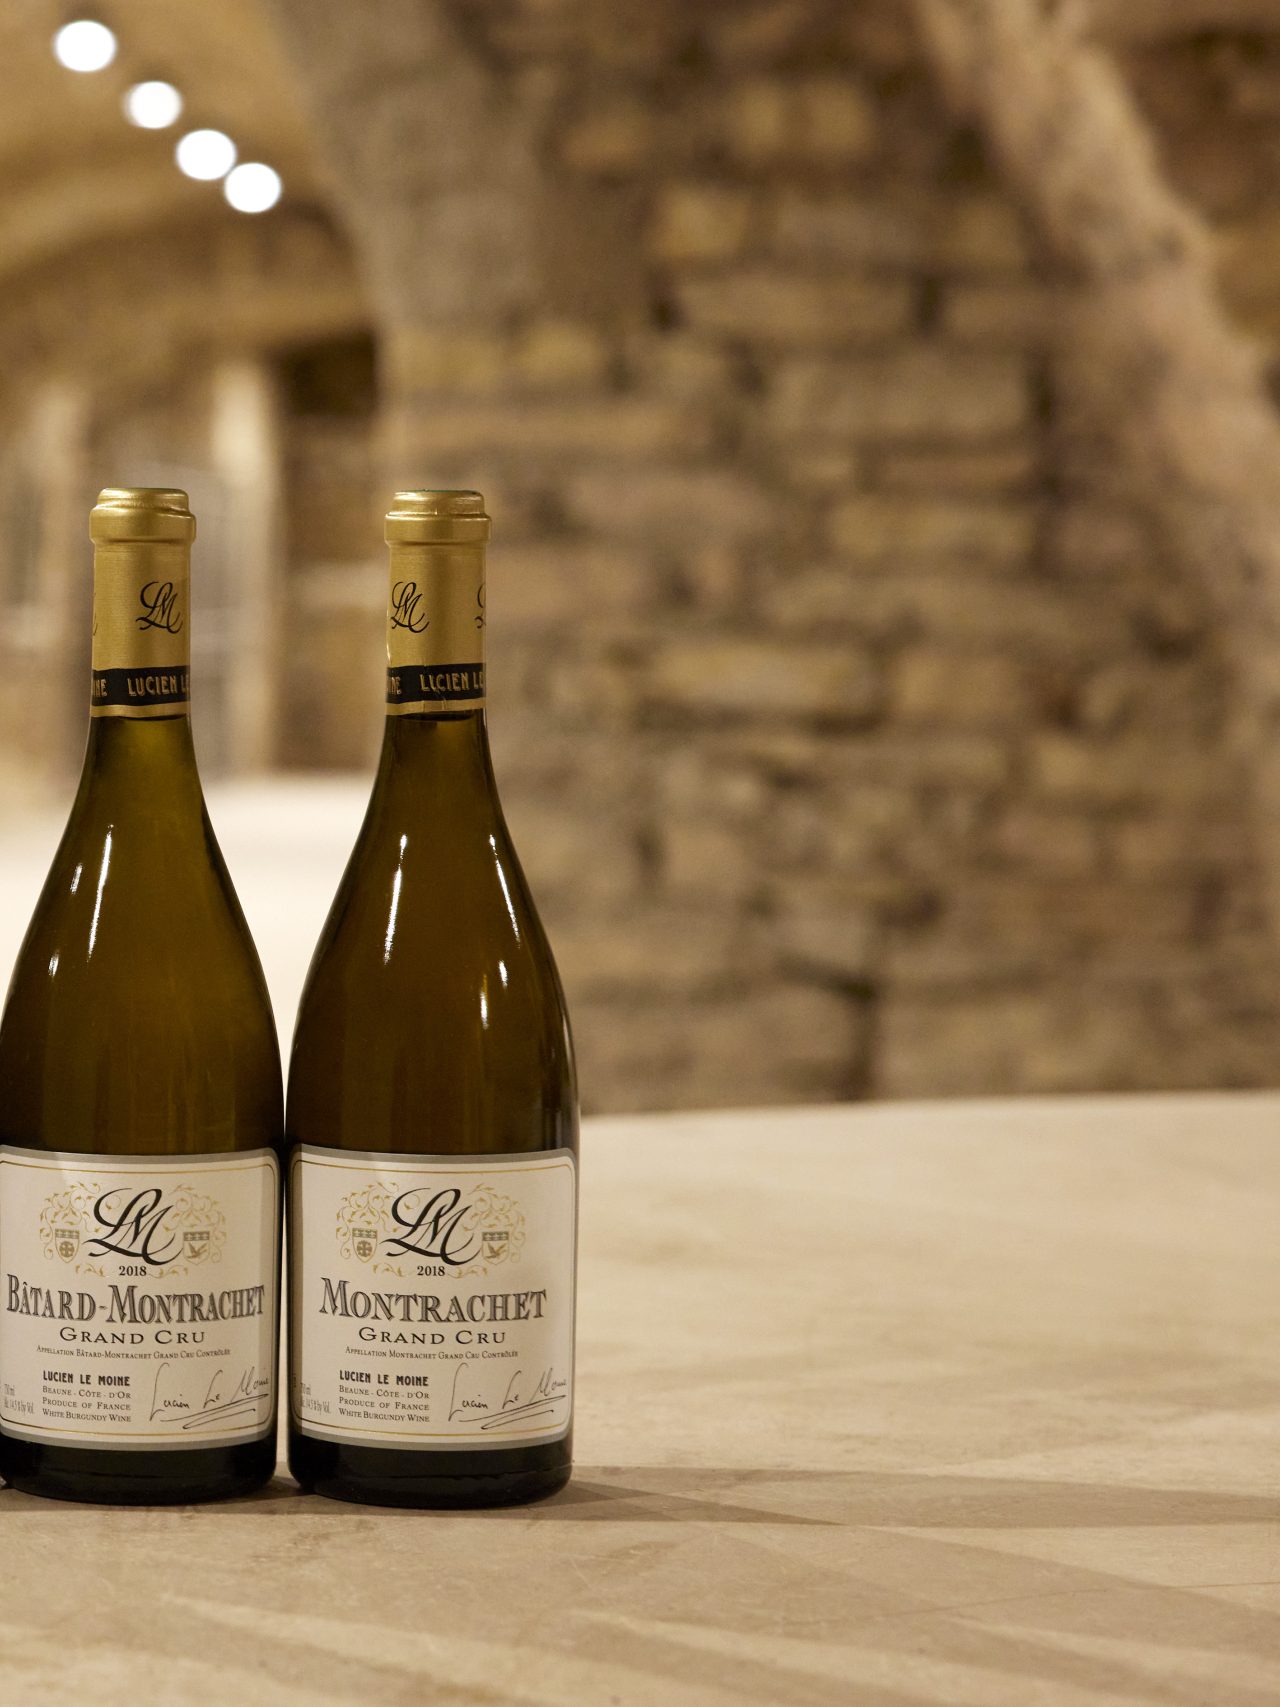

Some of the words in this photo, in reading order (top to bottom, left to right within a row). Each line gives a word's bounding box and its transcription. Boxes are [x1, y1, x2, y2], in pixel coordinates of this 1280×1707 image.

[127, 676, 178, 696] LUCIEN
[119, 1266, 147, 1276] 2018
[417, 1266, 445, 1276] 2018
[7, 1274, 265, 1324] BÂTARD-MONTRACHET
[319, 1277, 546, 1323] MONTRACHET
[60, 1327, 144, 1344] GRAND
[155, 1331, 205, 1344] CRU
[359, 1327, 445, 1344] GRAND
[456, 1331, 506, 1344] CRU
[37, 1345, 73, 1356] APPELLATION
[154, 1351, 178, 1359] GRAND
[345, 1346, 386, 1357] APPELLATION
[389, 1350, 436, 1359] MONTRACHET
[43, 1370, 73, 1383] LUCIEN
[80, 1374, 91, 1384] LE
[98, 1376, 130, 1386] MOINE
[340, 1370, 371, 1383] LUCIEN
[378, 1374, 389, 1384] LE
[396, 1375, 428, 1386] MOINE
[43, 1386, 71, 1395] BEAUNE
[79, 1389, 101, 1397] CÔTE
[339, 1385, 369, 1395] BEAUNE
[377, 1389, 399, 1397] CÔTE
[43, 1397, 77, 1407] PRODUCE
[97, 1402, 131, 1410] FRANCE
[339, 1397, 374, 1407] PRODUCE
[395, 1402, 429, 1410] FRANCE
[42, 1408, 64, 1418] WHITE
[66, 1411, 107, 1421] BURGUNDY
[109, 1414, 131, 1422] WINE
[339, 1408, 361, 1417] WHITE
[363, 1411, 405, 1421] BURGUNDY
[407, 1414, 429, 1422] WINE
